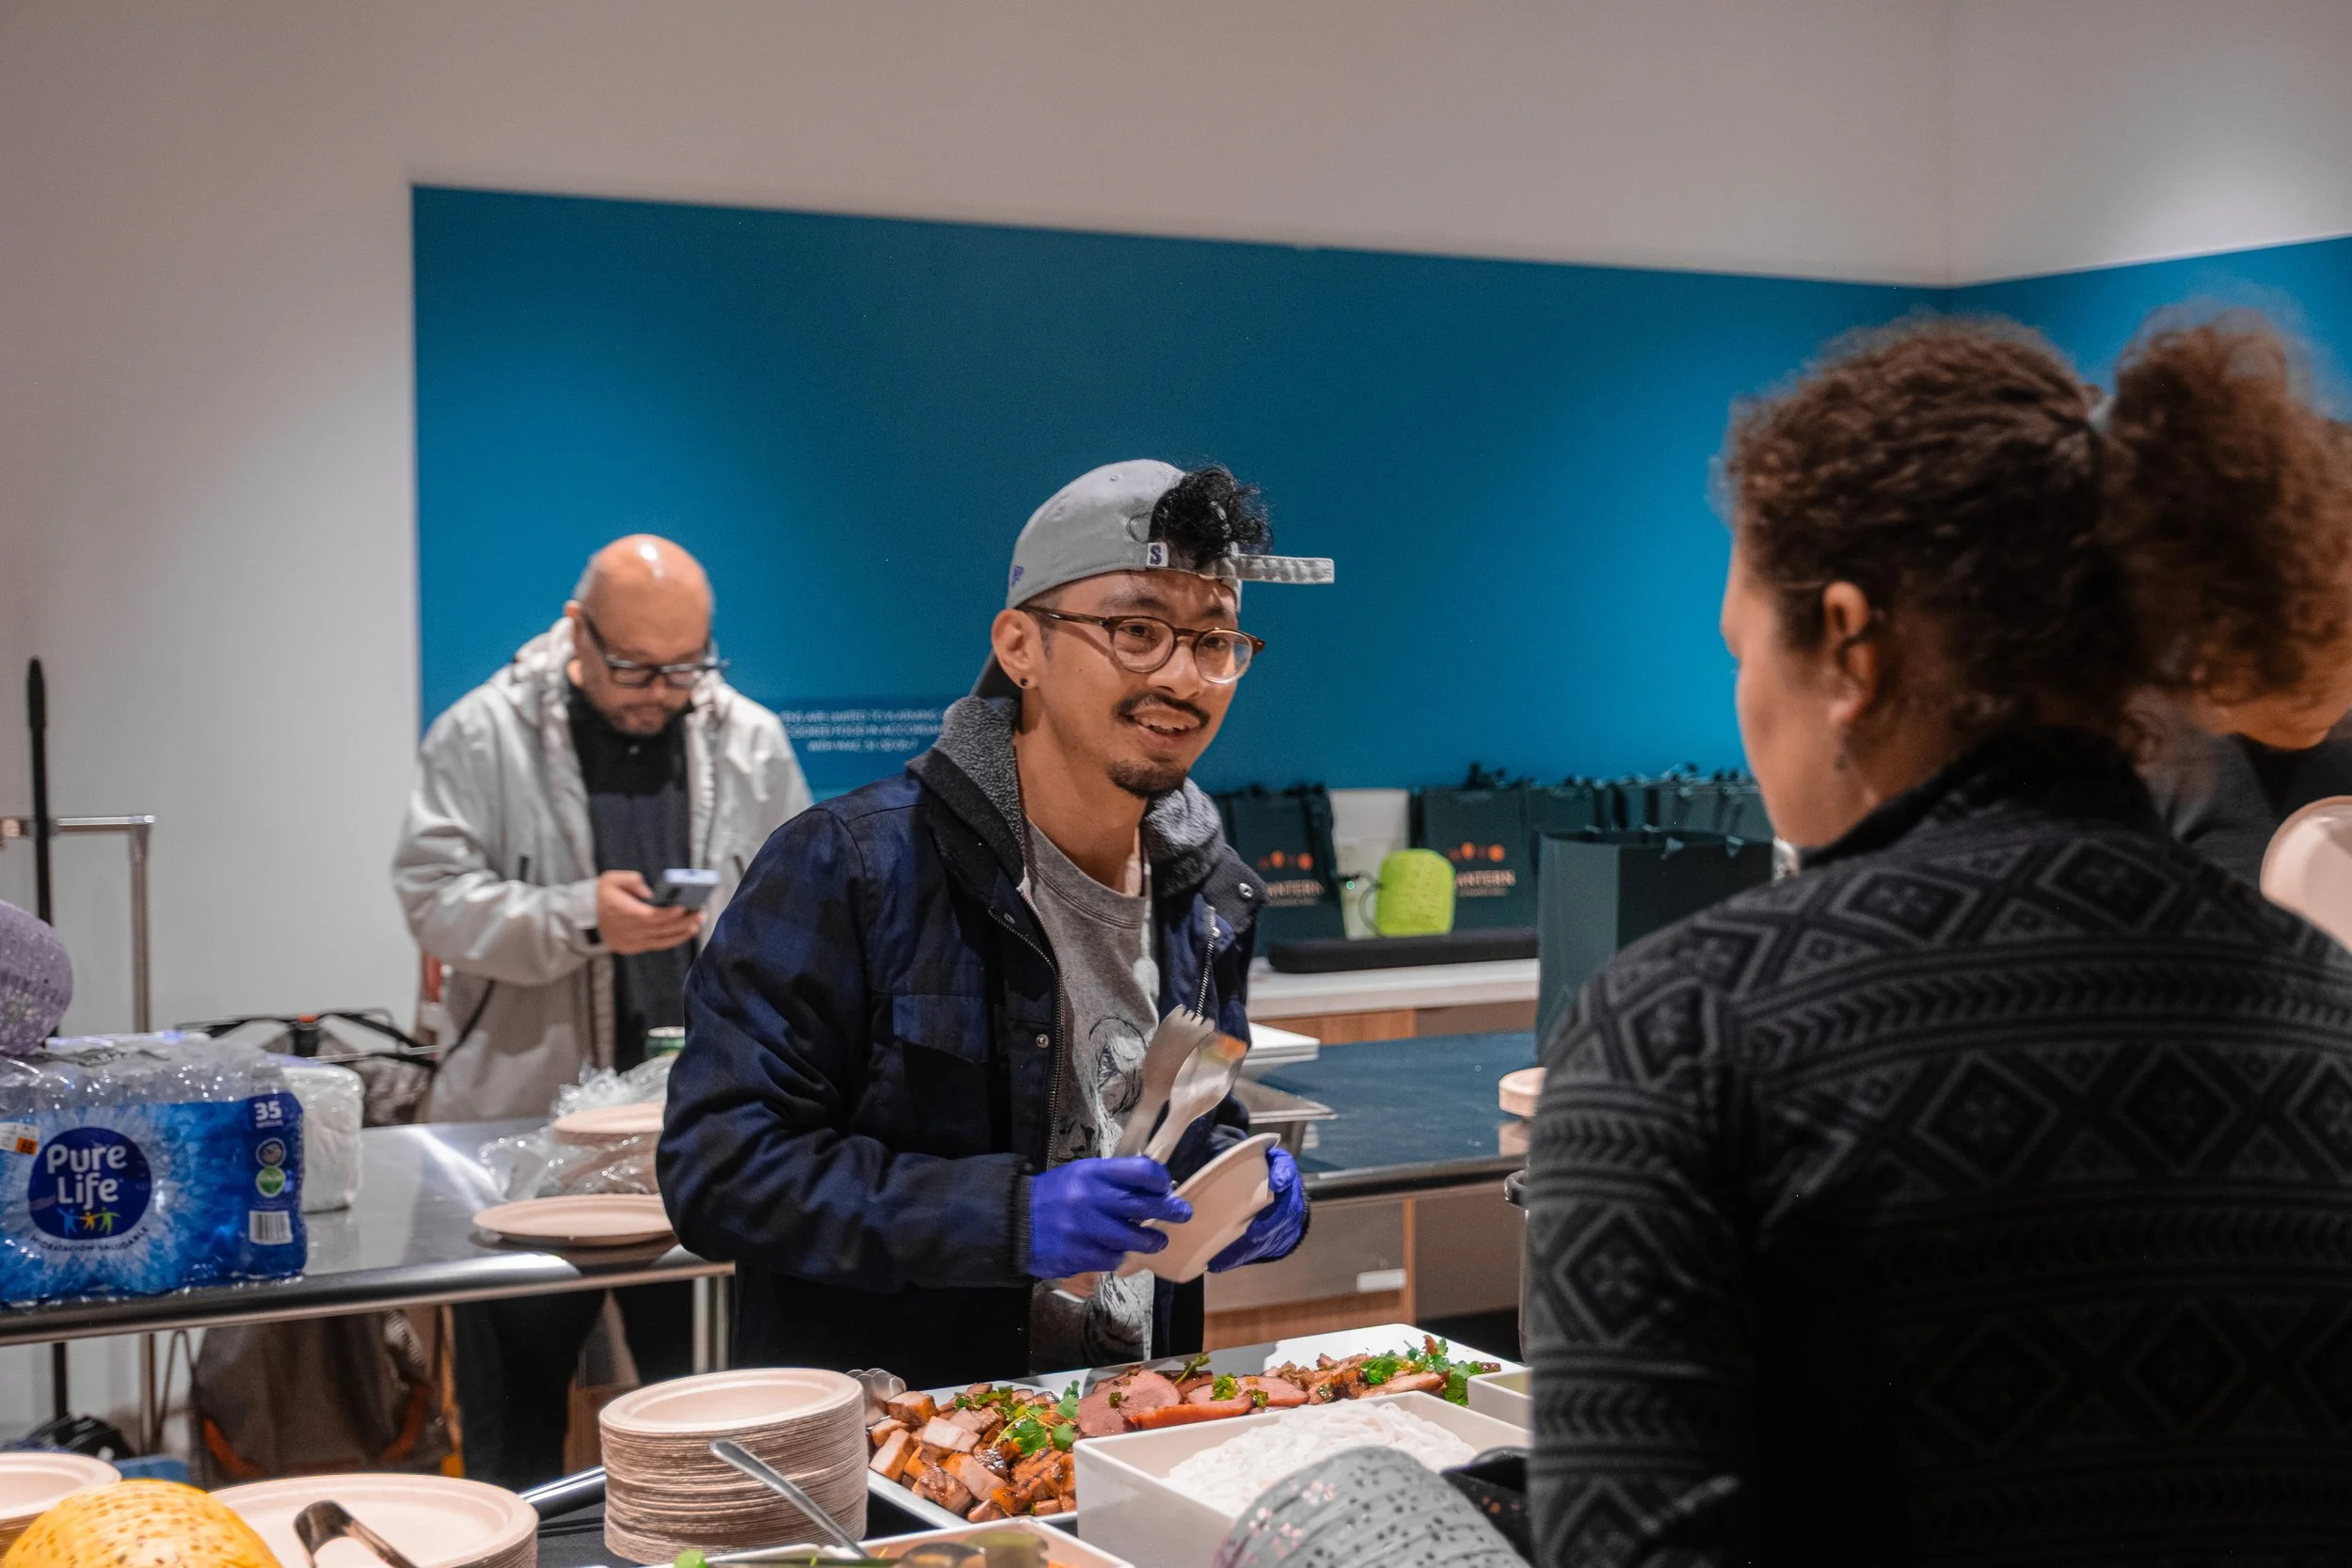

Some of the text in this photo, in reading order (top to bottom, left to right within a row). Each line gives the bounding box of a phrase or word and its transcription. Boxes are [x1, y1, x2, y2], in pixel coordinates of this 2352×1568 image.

[1266, 879, 1323, 896] ANTERN
[1455, 870, 1516, 887] ANTERN
[254, 1101, 282, 1121] 35
[47, 1144, 128, 1175] Pure
[57, 1172, 119, 1211] Life
